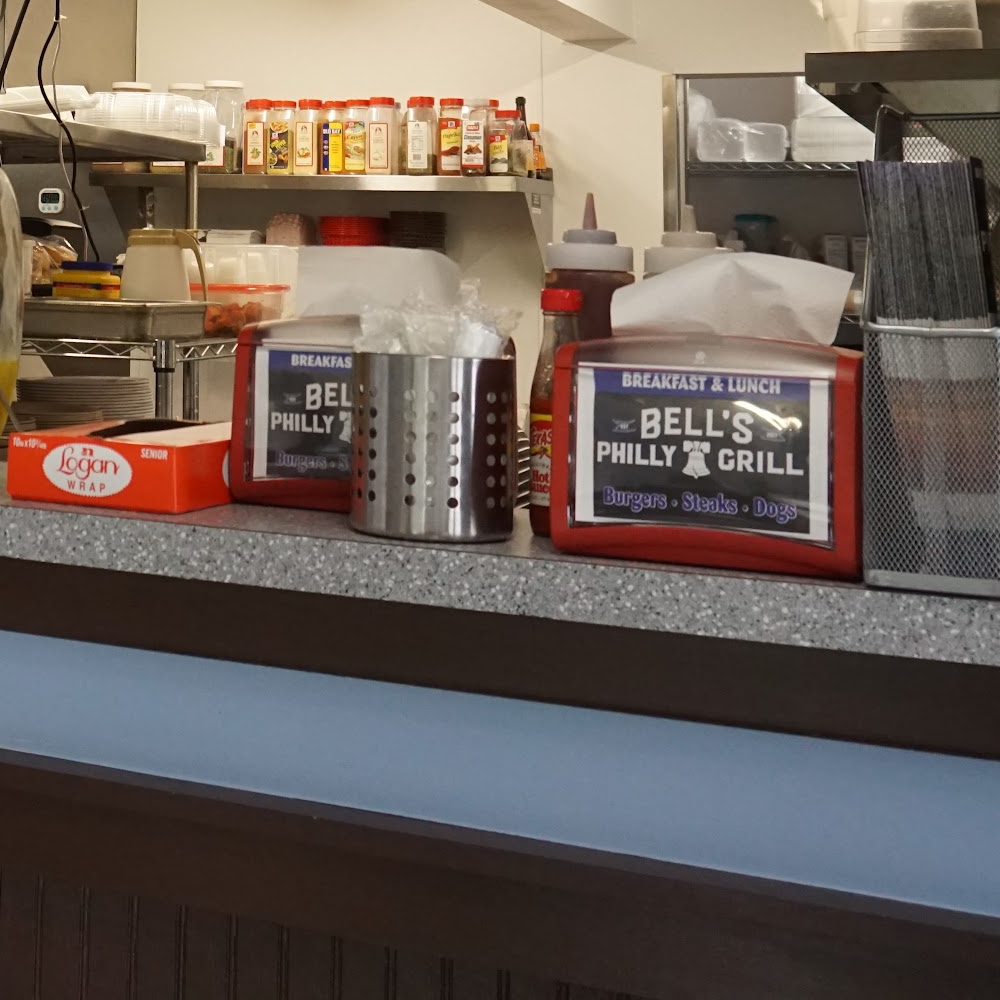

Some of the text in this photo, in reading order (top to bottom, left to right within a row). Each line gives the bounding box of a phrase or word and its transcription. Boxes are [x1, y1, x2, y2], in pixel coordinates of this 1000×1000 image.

[622, 371, 781, 395] BREAKFAST & LUNCH
[271, 411, 335, 434] PHILLY
[640, 406, 754, 444] BELL'S
[57, 447, 121, 480] Logan
[140, 448, 169, 460] SENIOR
[275, 451, 328, 473] Burgers
[597, 440, 804, 476] PHILLY GRILL
[67, 480, 106, 492] WRAP
[532, 470, 550, 483] Hot
[602, 487, 798, 524] Burgers Steaks Dogs
